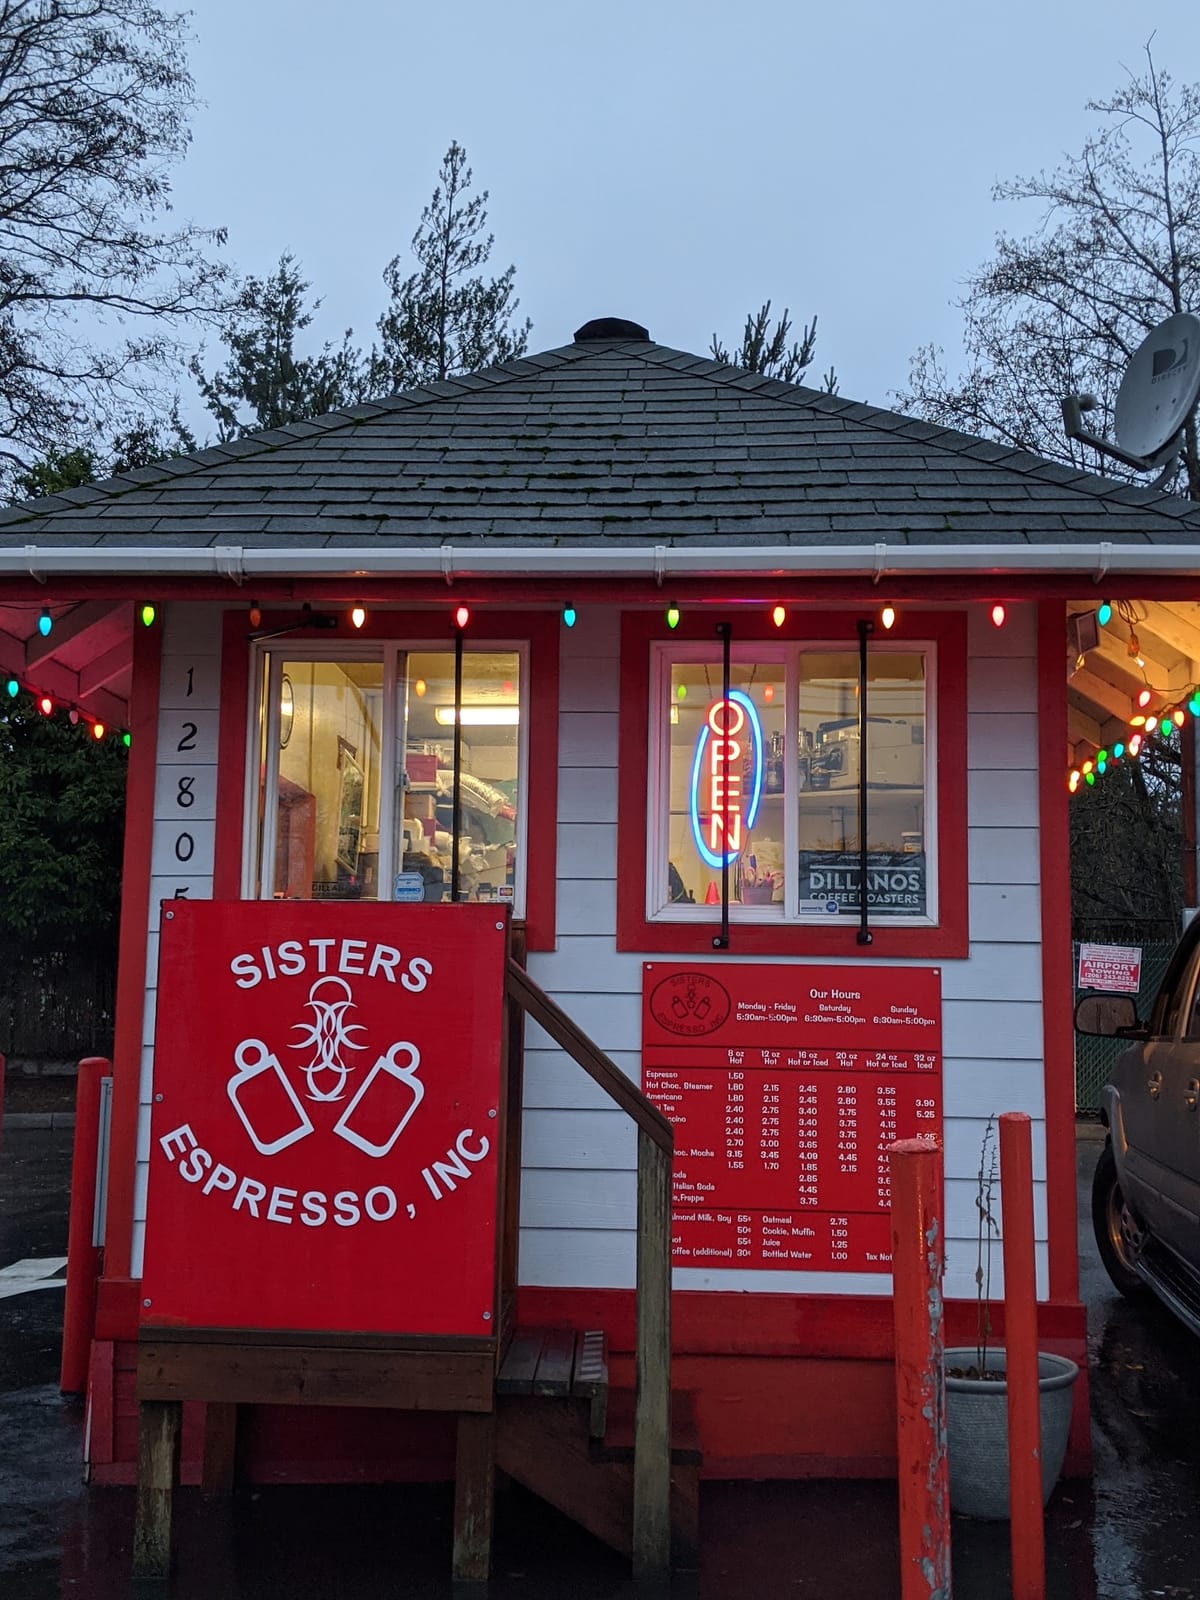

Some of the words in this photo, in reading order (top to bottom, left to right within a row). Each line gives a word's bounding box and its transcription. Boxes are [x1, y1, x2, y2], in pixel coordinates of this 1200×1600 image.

[708, 700, 744, 849] OPEN
[810, 892, 856, 903] COFFEE
[859, 893, 919, 904] OASTERS
[230, 938, 433, 993] SISTERS
[1084, 961, 1136, 971] AIRPORT
[1090, 968, 1131, 976] TOWING
[810, 988, 828, 999] Our
[831, 989, 861, 1000] Hours
[737, 1002, 767, 1012] Monday
[774, 1002, 797, 1013] Friday
[818, 1004, 851, 1014] Saturday
[890, 1005, 918, 1016] Sunday
[761, 1050, 769, 1058] 12
[788, 1058, 800, 1066] Hot
[840, 1059, 853, 1067] Hot
[866, 1060, 879, 1068] Hot
[891, 1061, 907, 1069] Iced
[646, 1070, 678, 1079] Espresso
[683, 1082, 713, 1090] Steamer
[763, 1084, 780, 1092] 2.15
[799, 1085, 817, 1093] 2.45
[877, 1087, 896, 1095] 3.55
[646, 1092, 682, 1100] Americano
[763, 1095, 780, 1103] 2.15
[799, 1096, 817, 1104] 2.45
[877, 1098, 896, 1106] 3.55
[725, 1105, 744, 1113] 2.40
[762, 1106, 780, 1114] 2.75
[798, 1107, 817, 1115] 3.40
[838, 1108, 857, 1116] 3.75
[725, 1116, 744, 1124] 2.40
[762, 1117, 780, 1125] 2.75
[798, 1118, 817, 1126] 3.40
[839, 1119, 857, 1128] 3.75
[880, 1121, 896, 1129] 4.15
[762, 1128, 779, 1136] 2.75
[880, 1132, 896, 1140] 4.15
[799, 1141, 818, 1149] 3.65
[690, 1149, 715, 1157] Mocha
[727, 1150, 743, 1158] 3.15
[760, 1151, 779, 1159] 3.45
[838, 1153, 858, 1161] 4.45
[421, 1128, 490, 1200] INC
[764, 1162, 779, 1170] 1.70
[841, 1164, 857, 1172] 2.15
[673, 1170, 687, 1179] oda
[673, 1182, 695, 1190] Italian
[697, 1182, 715, 1191] Soda
[800, 1197, 818, 1205] 3.75
[717, 1214, 732, 1224] Soy
[762, 1216, 792, 1224] Oatmeal
[830, 1218, 848, 1226] 2.75
[762, 1227, 789, 1236] Cookie,
[792, 1228, 815, 1236] Muffin
[831, 1229, 848, 1237] 1.50
[672, 1247, 691, 1255] offee
[692, 1248, 733, 1258] (additional)
[762, 1250, 788, 1258] Bottled
[790, 1251, 812, 1259] Water
[831, 1252, 848, 1260] 1.00
